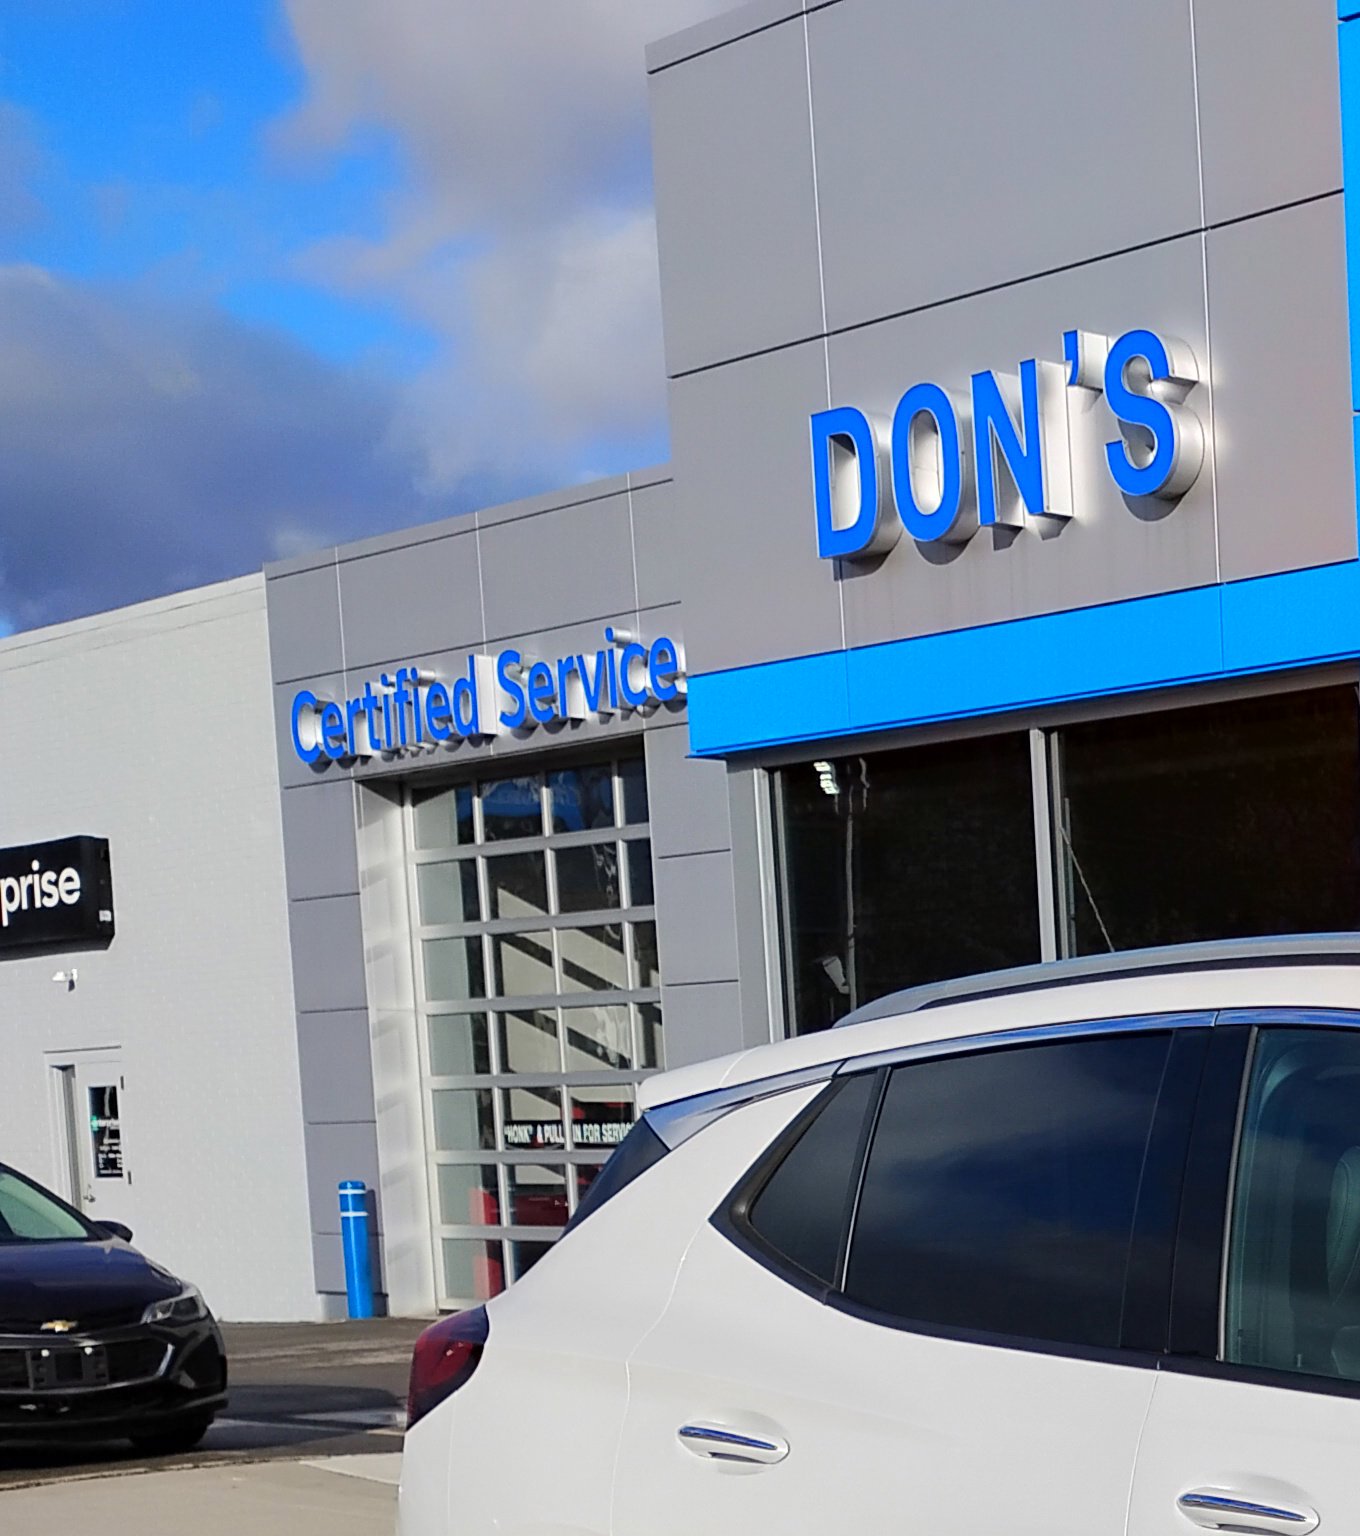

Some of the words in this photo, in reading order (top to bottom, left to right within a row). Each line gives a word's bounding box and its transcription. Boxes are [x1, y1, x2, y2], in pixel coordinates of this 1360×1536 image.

[808, 328, 1177, 559] DON'S
[291, 654, 481, 765] Certified
[498, 626, 680, 729] Service
[0, 858, 81, 928] prise
[543, 1123, 565, 1143] PULL
[571, 1122, 581, 1142] IN
[582, 1122, 601, 1142] FOR
[601, 1122, 635, 1142] SERVIC
